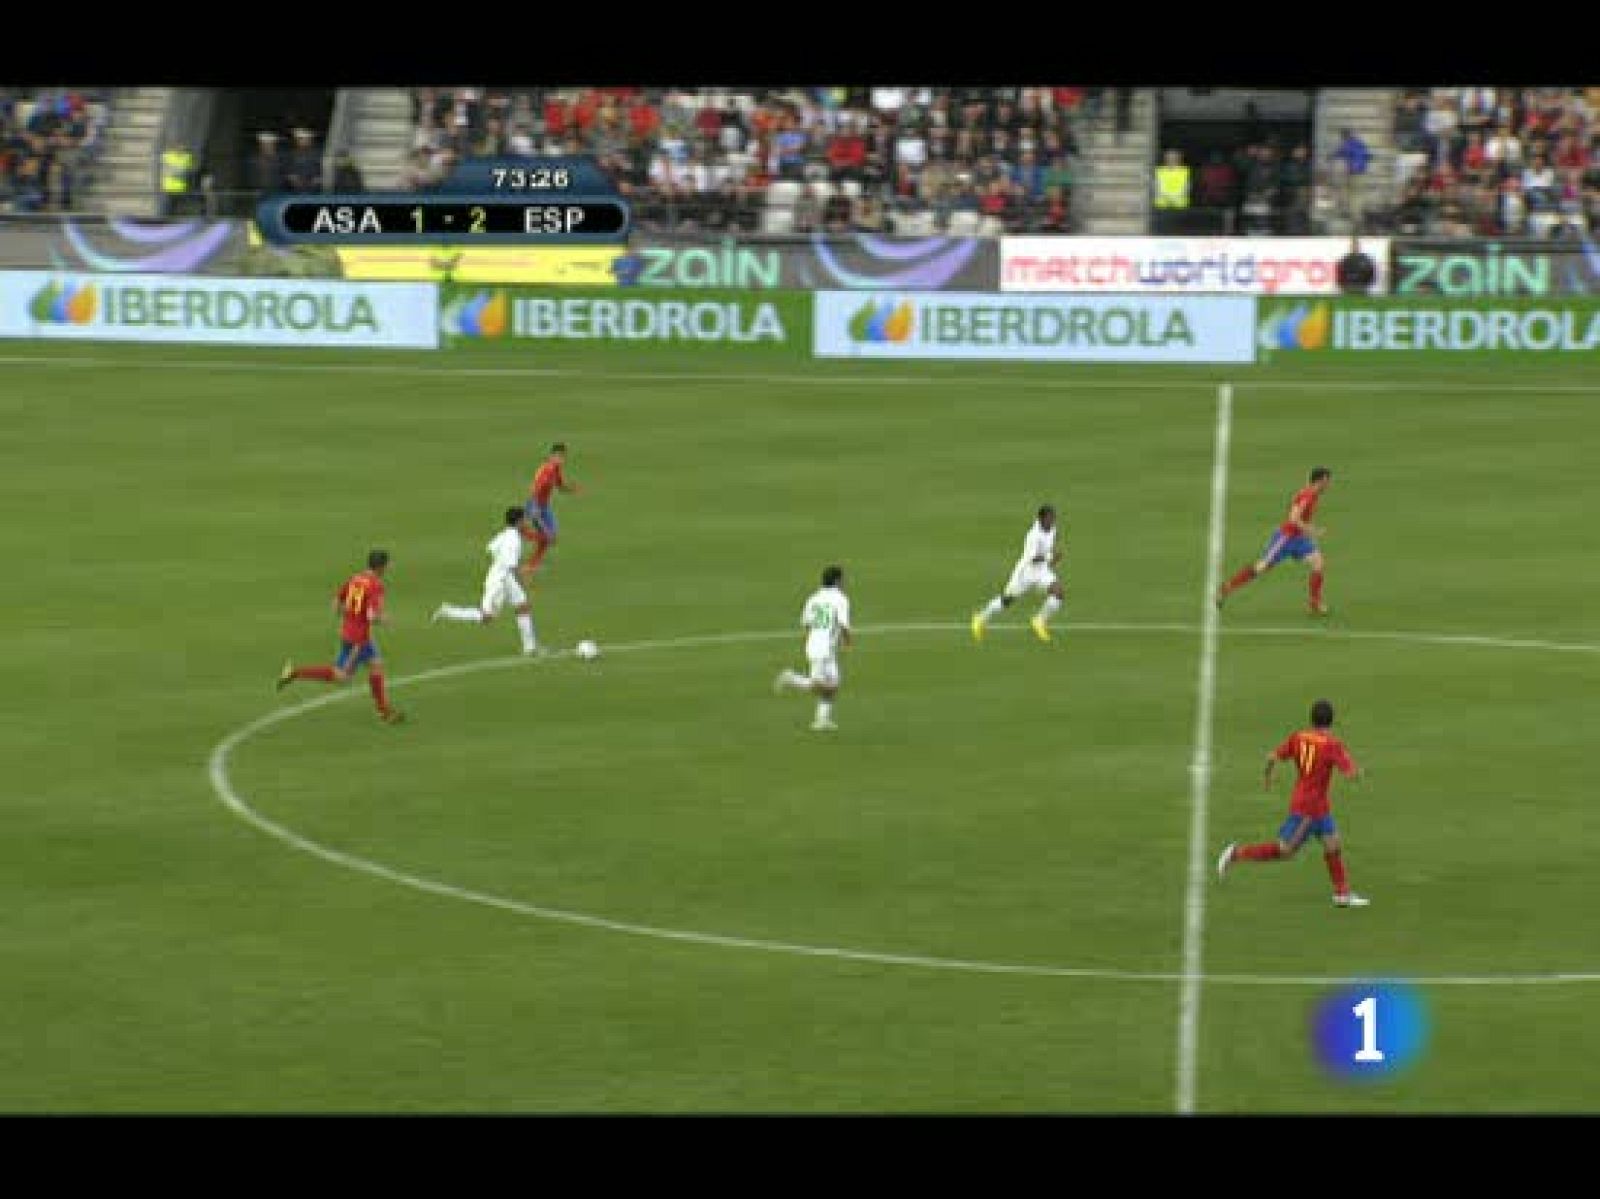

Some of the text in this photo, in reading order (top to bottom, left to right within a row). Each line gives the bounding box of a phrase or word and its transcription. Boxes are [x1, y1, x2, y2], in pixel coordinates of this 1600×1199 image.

[1004, 254, 1344, 293] matchworldgro
[104, 286, 379, 333] IBERDROLA
[513, 297, 786, 343] IBERDROLA
[921, 306, 1195, 347] IBERDROLA
